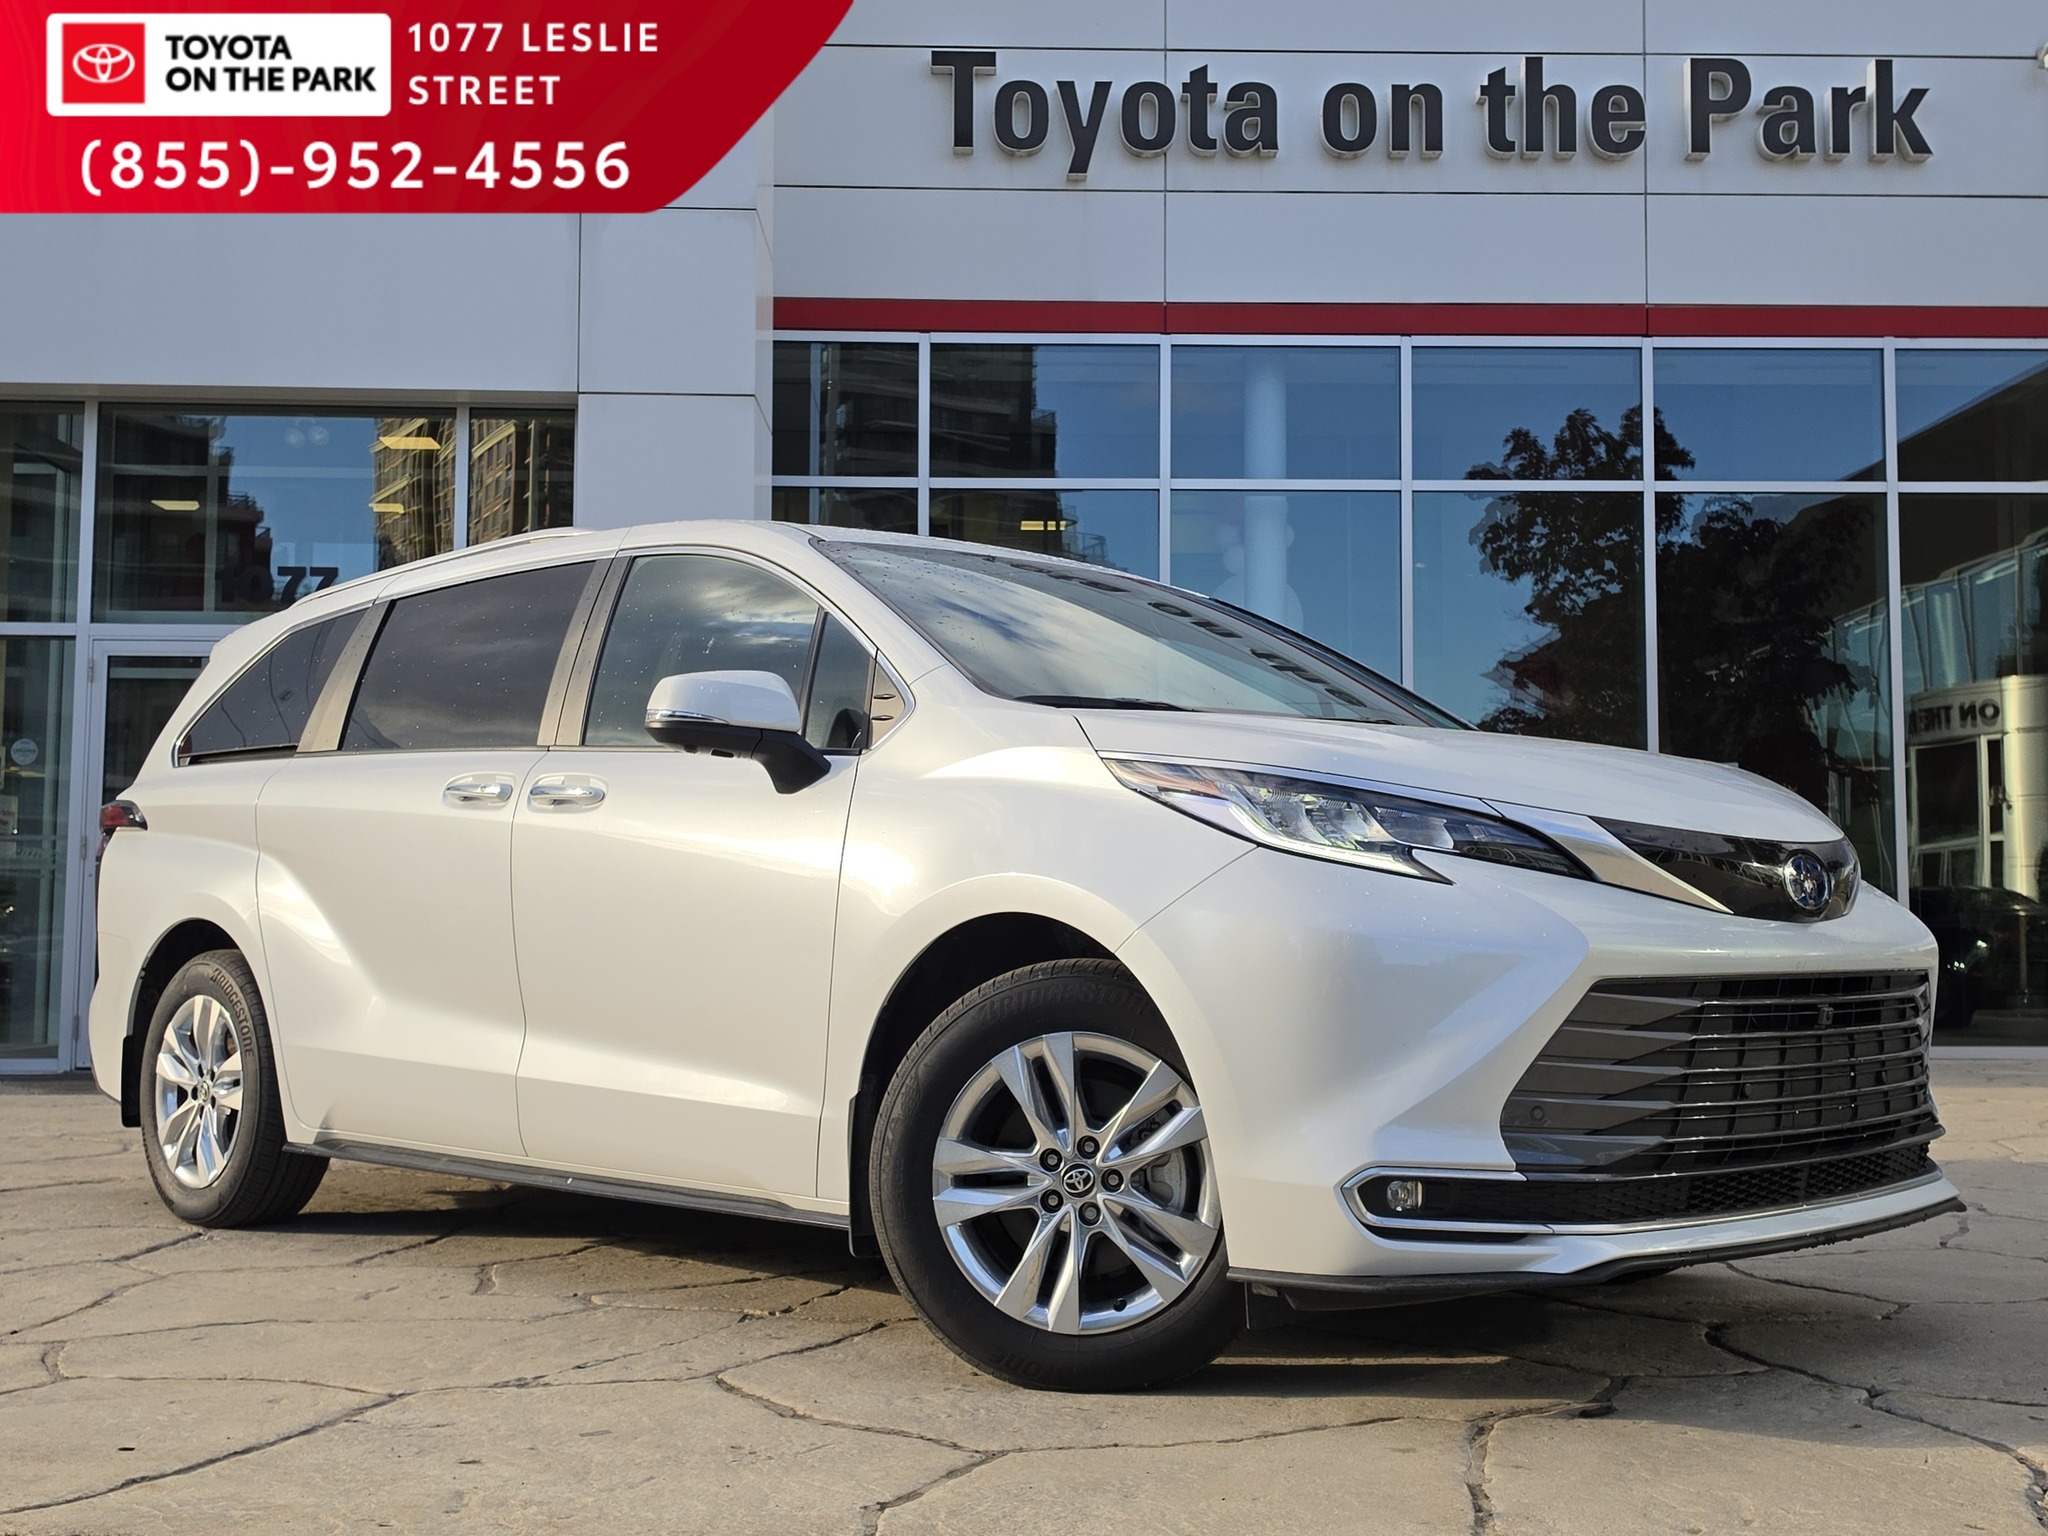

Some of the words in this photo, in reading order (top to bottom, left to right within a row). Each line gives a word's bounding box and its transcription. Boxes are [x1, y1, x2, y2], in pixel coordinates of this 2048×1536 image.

[930, 50, 1279, 182] Toyota
[1321, 82, 1444, 160] on
[1476, 56, 1647, 161] the
[1683, 57, 1933, 162] Park
[209, 967, 254, 1058] BRIDGESTONE
